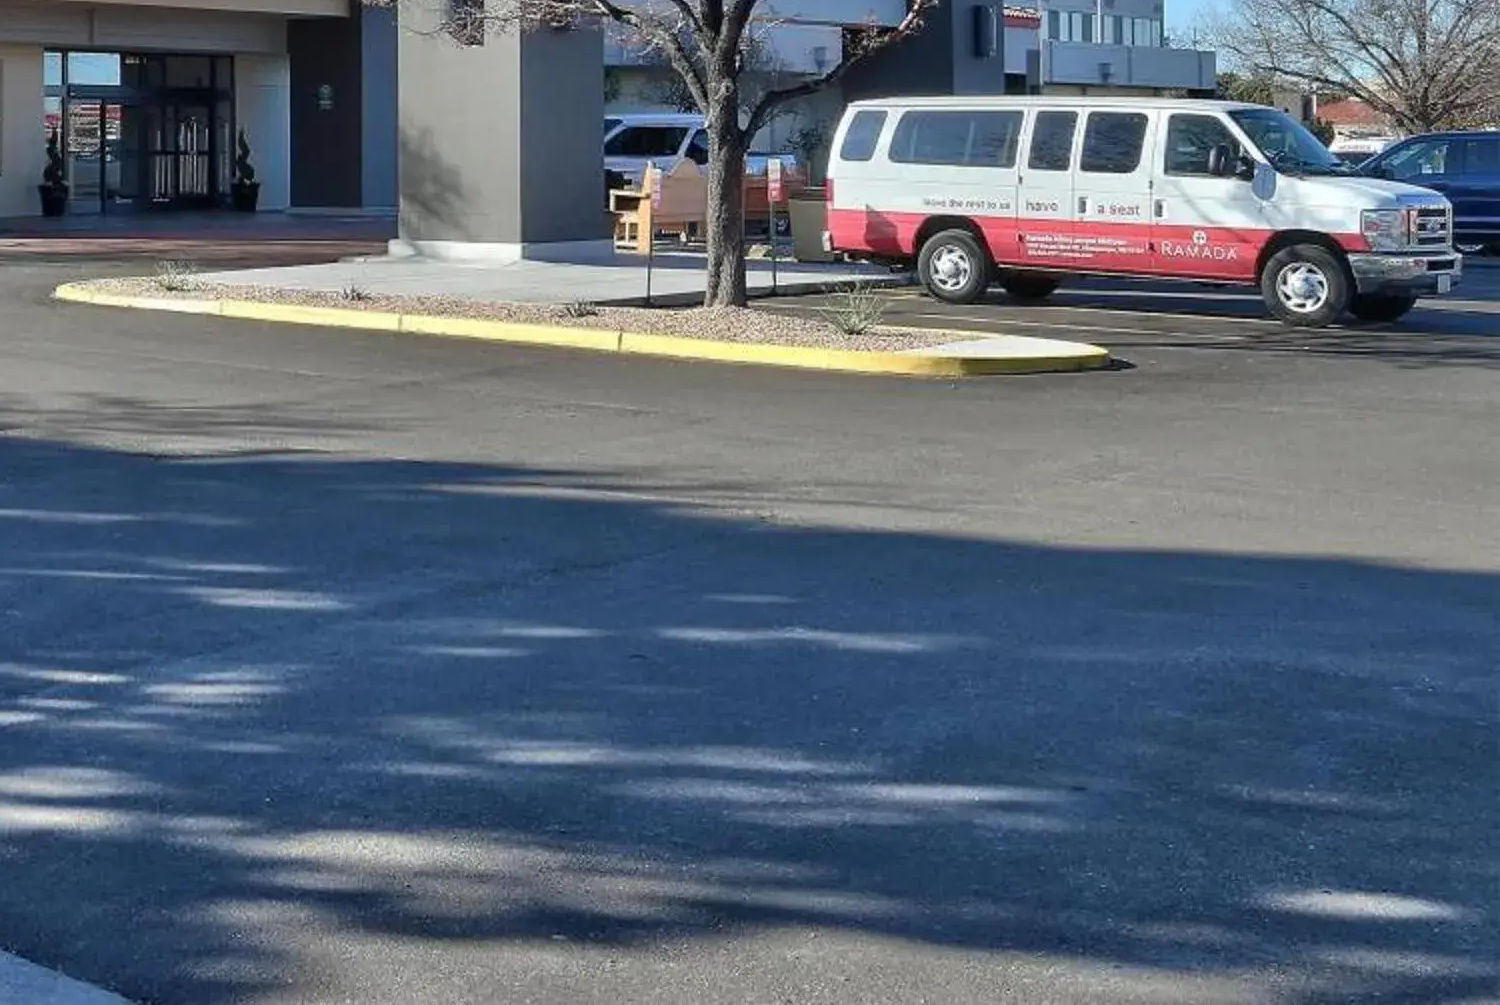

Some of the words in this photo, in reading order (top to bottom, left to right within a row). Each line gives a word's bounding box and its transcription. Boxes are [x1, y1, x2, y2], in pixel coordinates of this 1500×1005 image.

[1025, 199, 1059, 212] have
[1097, 204, 1105, 214] a
[1109, 204, 1141, 215] seat
[1161, 240, 1238, 260] RAMADA
